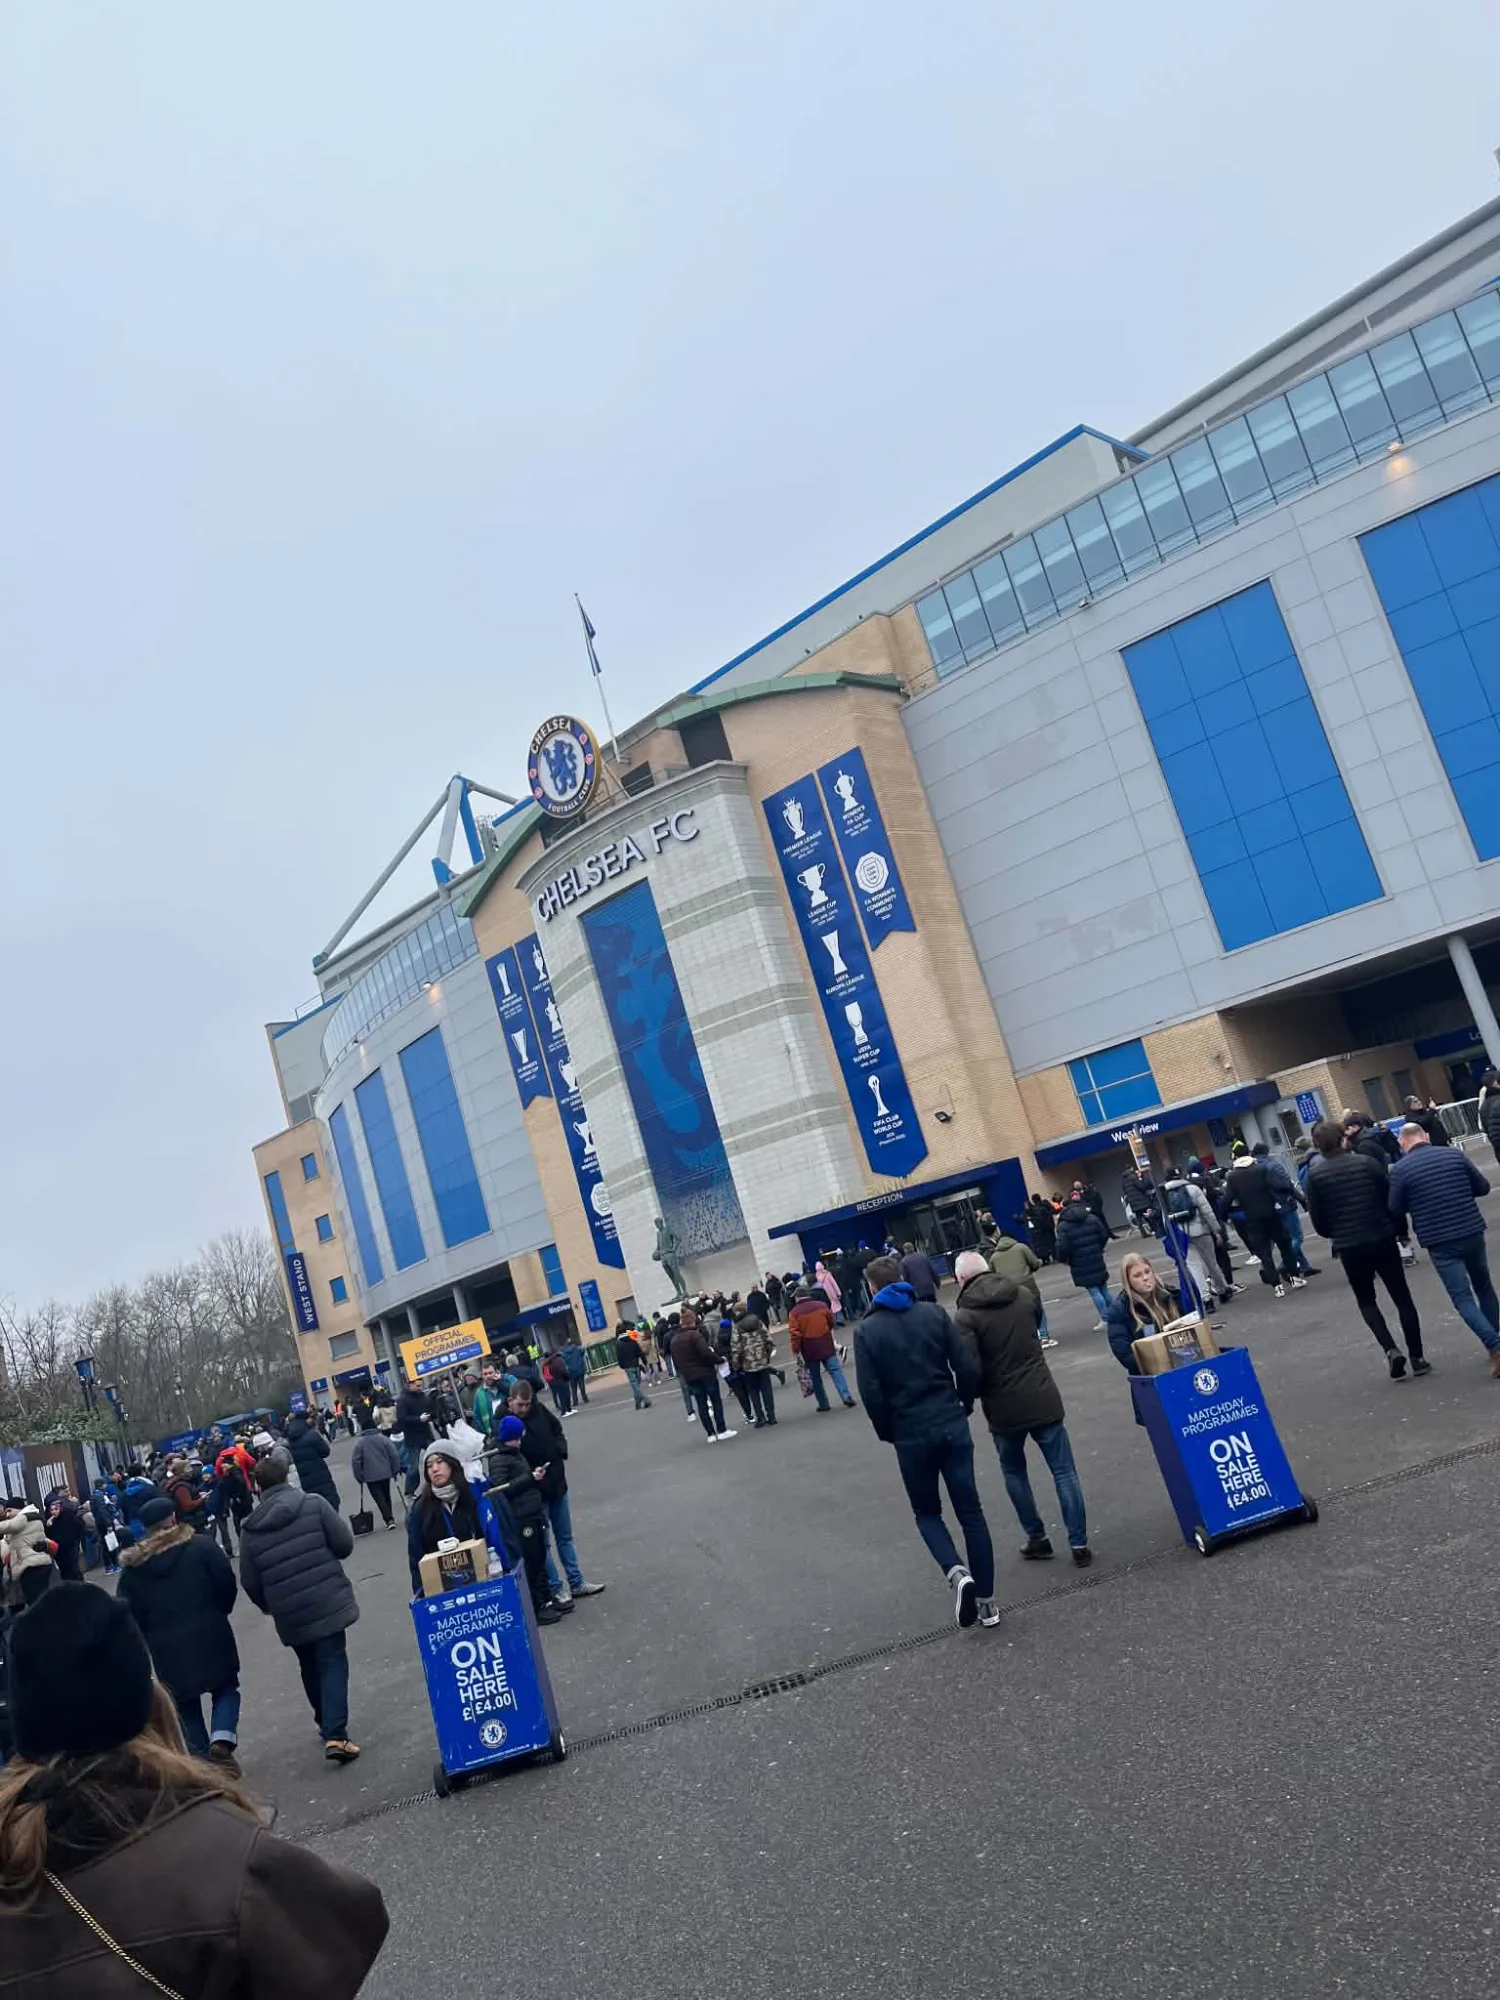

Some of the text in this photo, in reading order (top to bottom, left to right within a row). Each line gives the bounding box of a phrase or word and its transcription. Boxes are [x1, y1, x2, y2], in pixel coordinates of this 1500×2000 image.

[530, 718, 571, 754] CHELSEA
[536, 808, 700, 922] CHELSEA FC
[856, 1192, 903, 1212] RECEPTION
[294, 1259, 314, 1323] WEST STAND
[415, 1334, 476, 1360] PROGRAMMES
[422, 1329, 462, 1347] OFFICIAL
[1181, 1404, 1259, 1438] PROGRAMMES
[1188, 1396, 1244, 1424] MATCHDAY
[1209, 1431, 1253, 1463] ON
[1216, 1453, 1259, 1480] SALE
[1221, 1468, 1264, 1493] HERE
[1234, 1484, 1266, 1506] £4.00
[428, 1611, 514, 1645] PROGRAMMES
[437, 1602, 500, 1631] MATCHDAY
[451, 1632, 502, 1669] ON
[456, 1659, 506, 1687] SALE
[459, 1675, 509, 1703] HERE
[475, 1693, 512, 1715] £4.00
